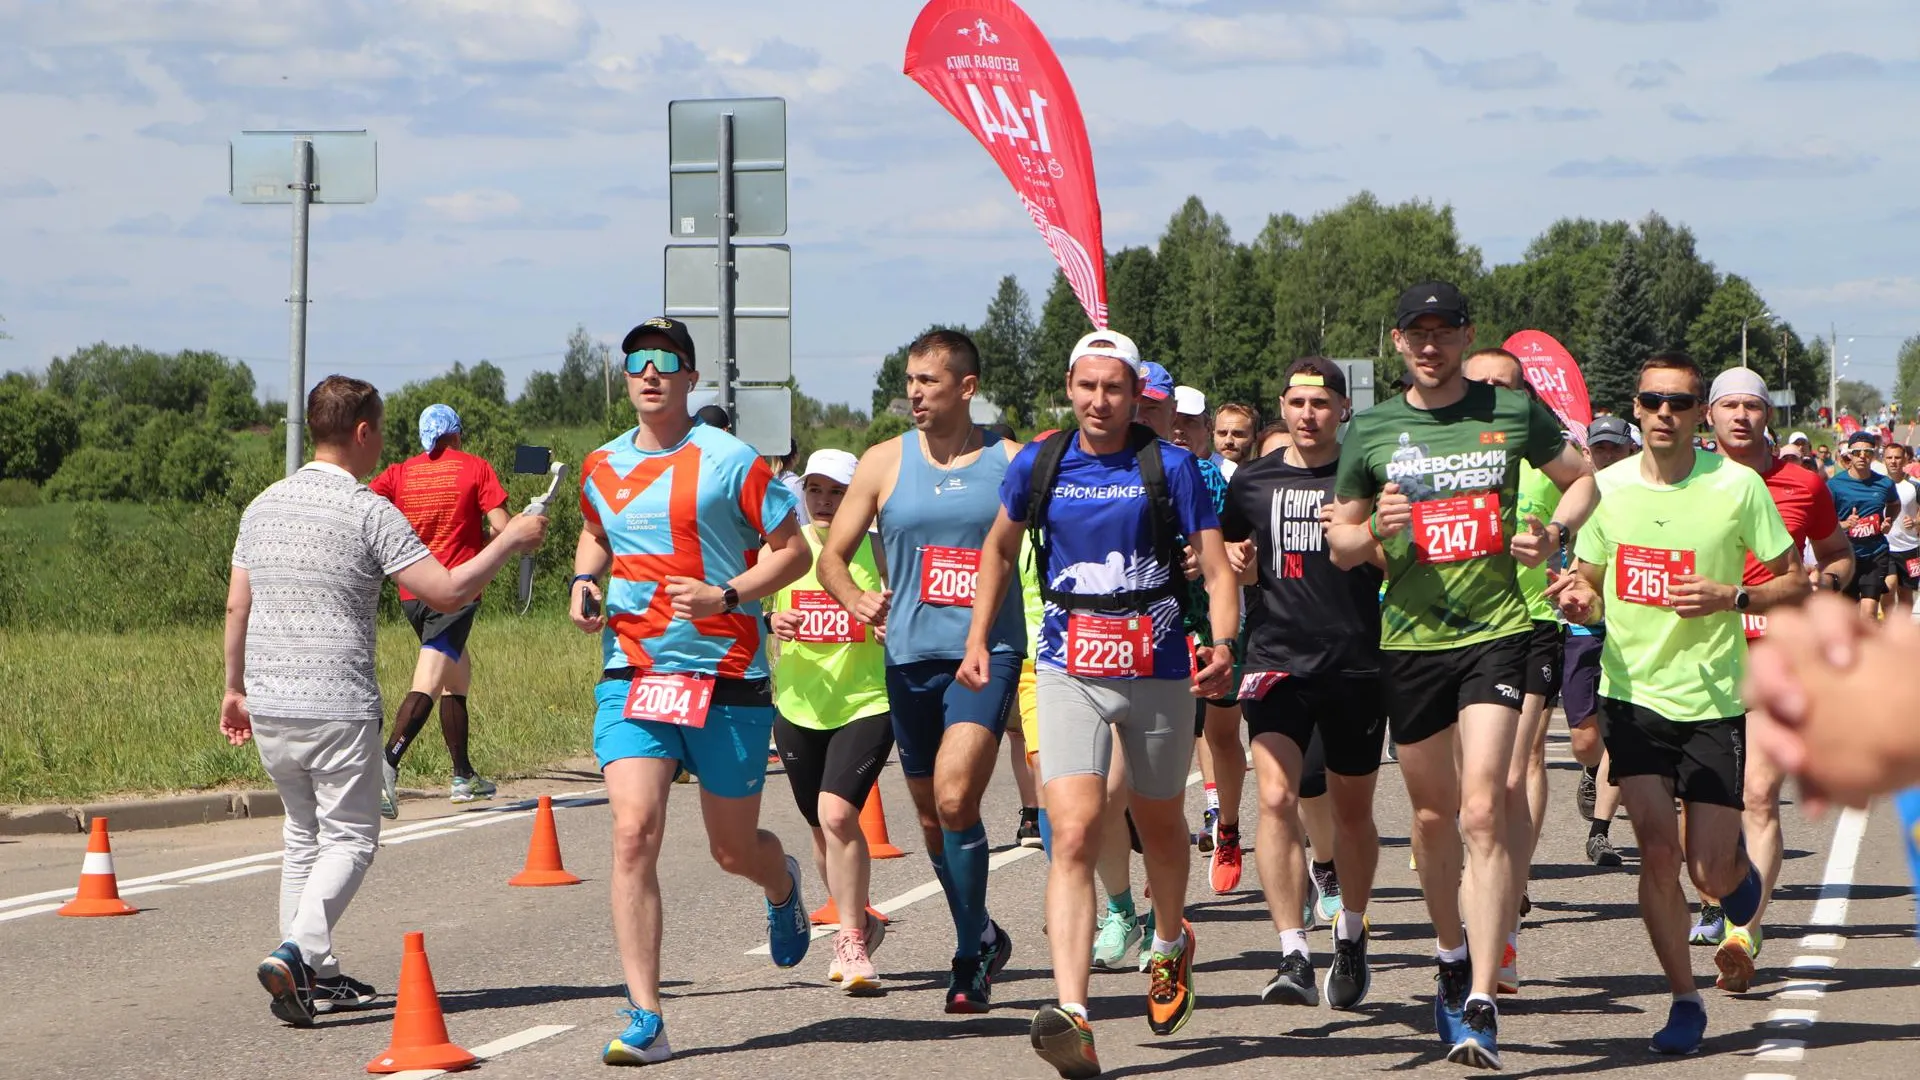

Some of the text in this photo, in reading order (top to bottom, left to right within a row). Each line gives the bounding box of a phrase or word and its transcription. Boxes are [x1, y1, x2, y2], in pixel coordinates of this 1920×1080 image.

[1386, 450, 1506, 480] РЖЕВСКИЙ
[1433, 467, 1506, 492] РУБЕЖ
[1054, 484, 1147, 499] ЕЙСМЕЙКЕР
[1284, 488, 1325, 519] CHIPS
[1425, 519, 1479, 555] 2147
[1627, 567, 1670, 599] 2151
[799, 610, 850, 636] 2028
[1074, 638, 1134, 669] 2228
[631, 684, 692, 718] 2004
